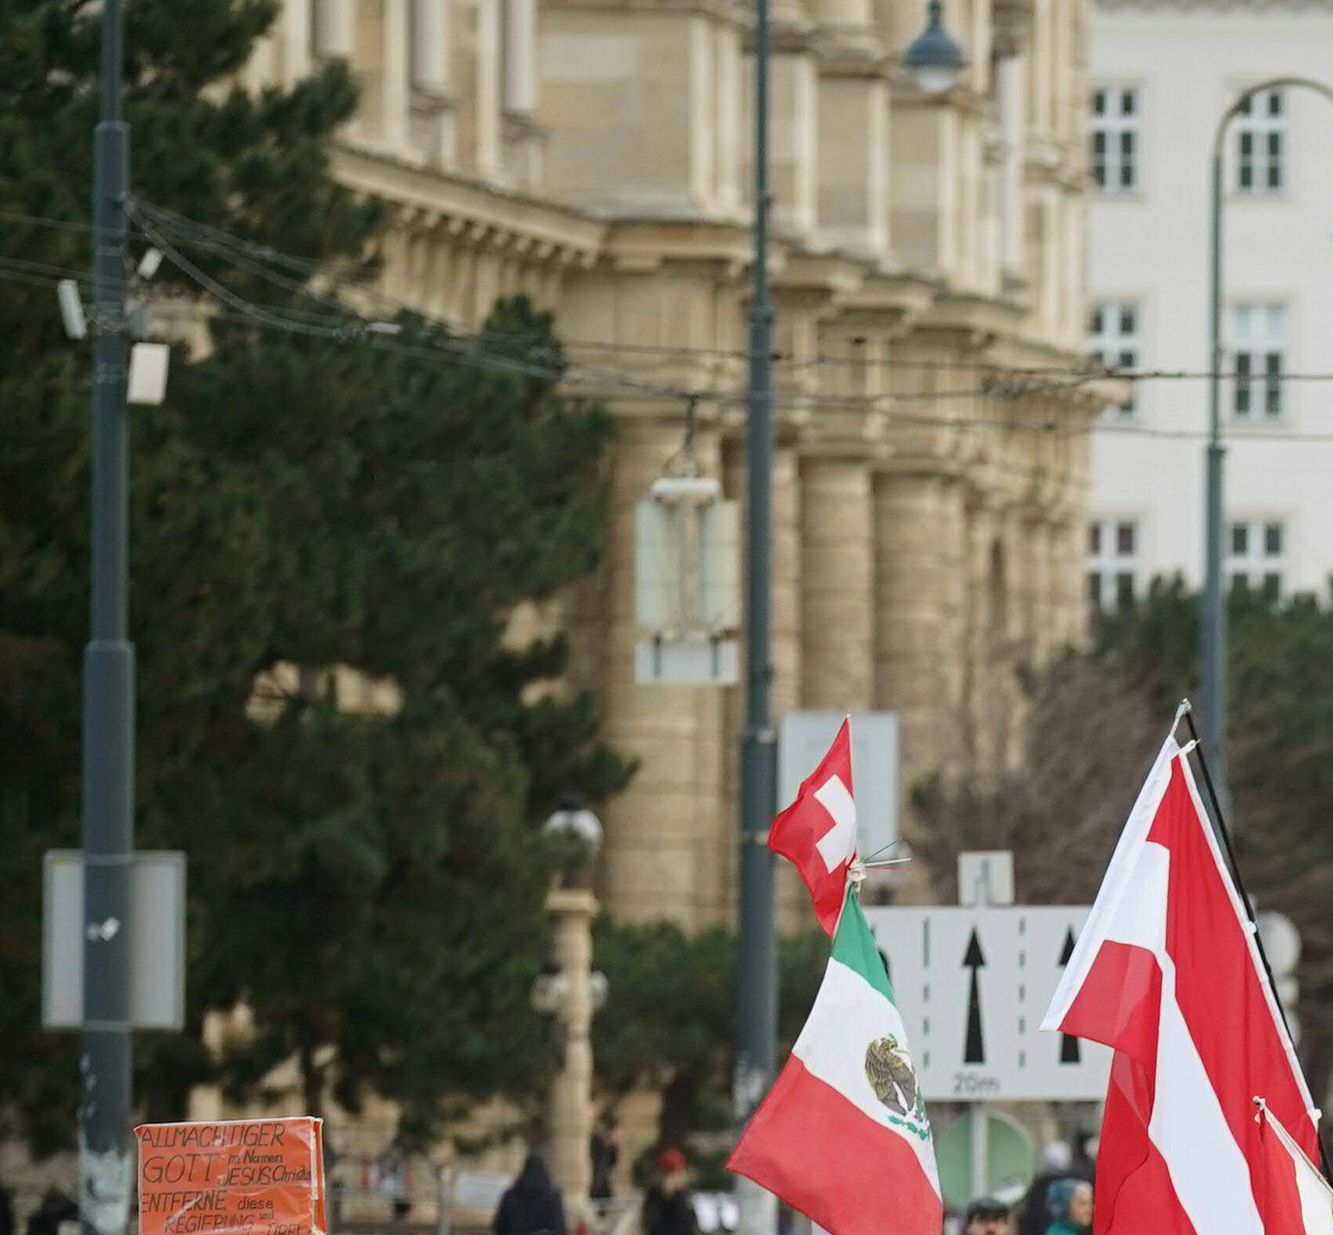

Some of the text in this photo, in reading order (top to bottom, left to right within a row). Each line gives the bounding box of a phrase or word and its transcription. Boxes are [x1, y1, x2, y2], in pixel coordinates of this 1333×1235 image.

[143, 1153, 219, 1184] GOTT
[218, 1166, 271, 1186] JESUS
[142, 1189, 274, 1214] ENTFERNE diese
